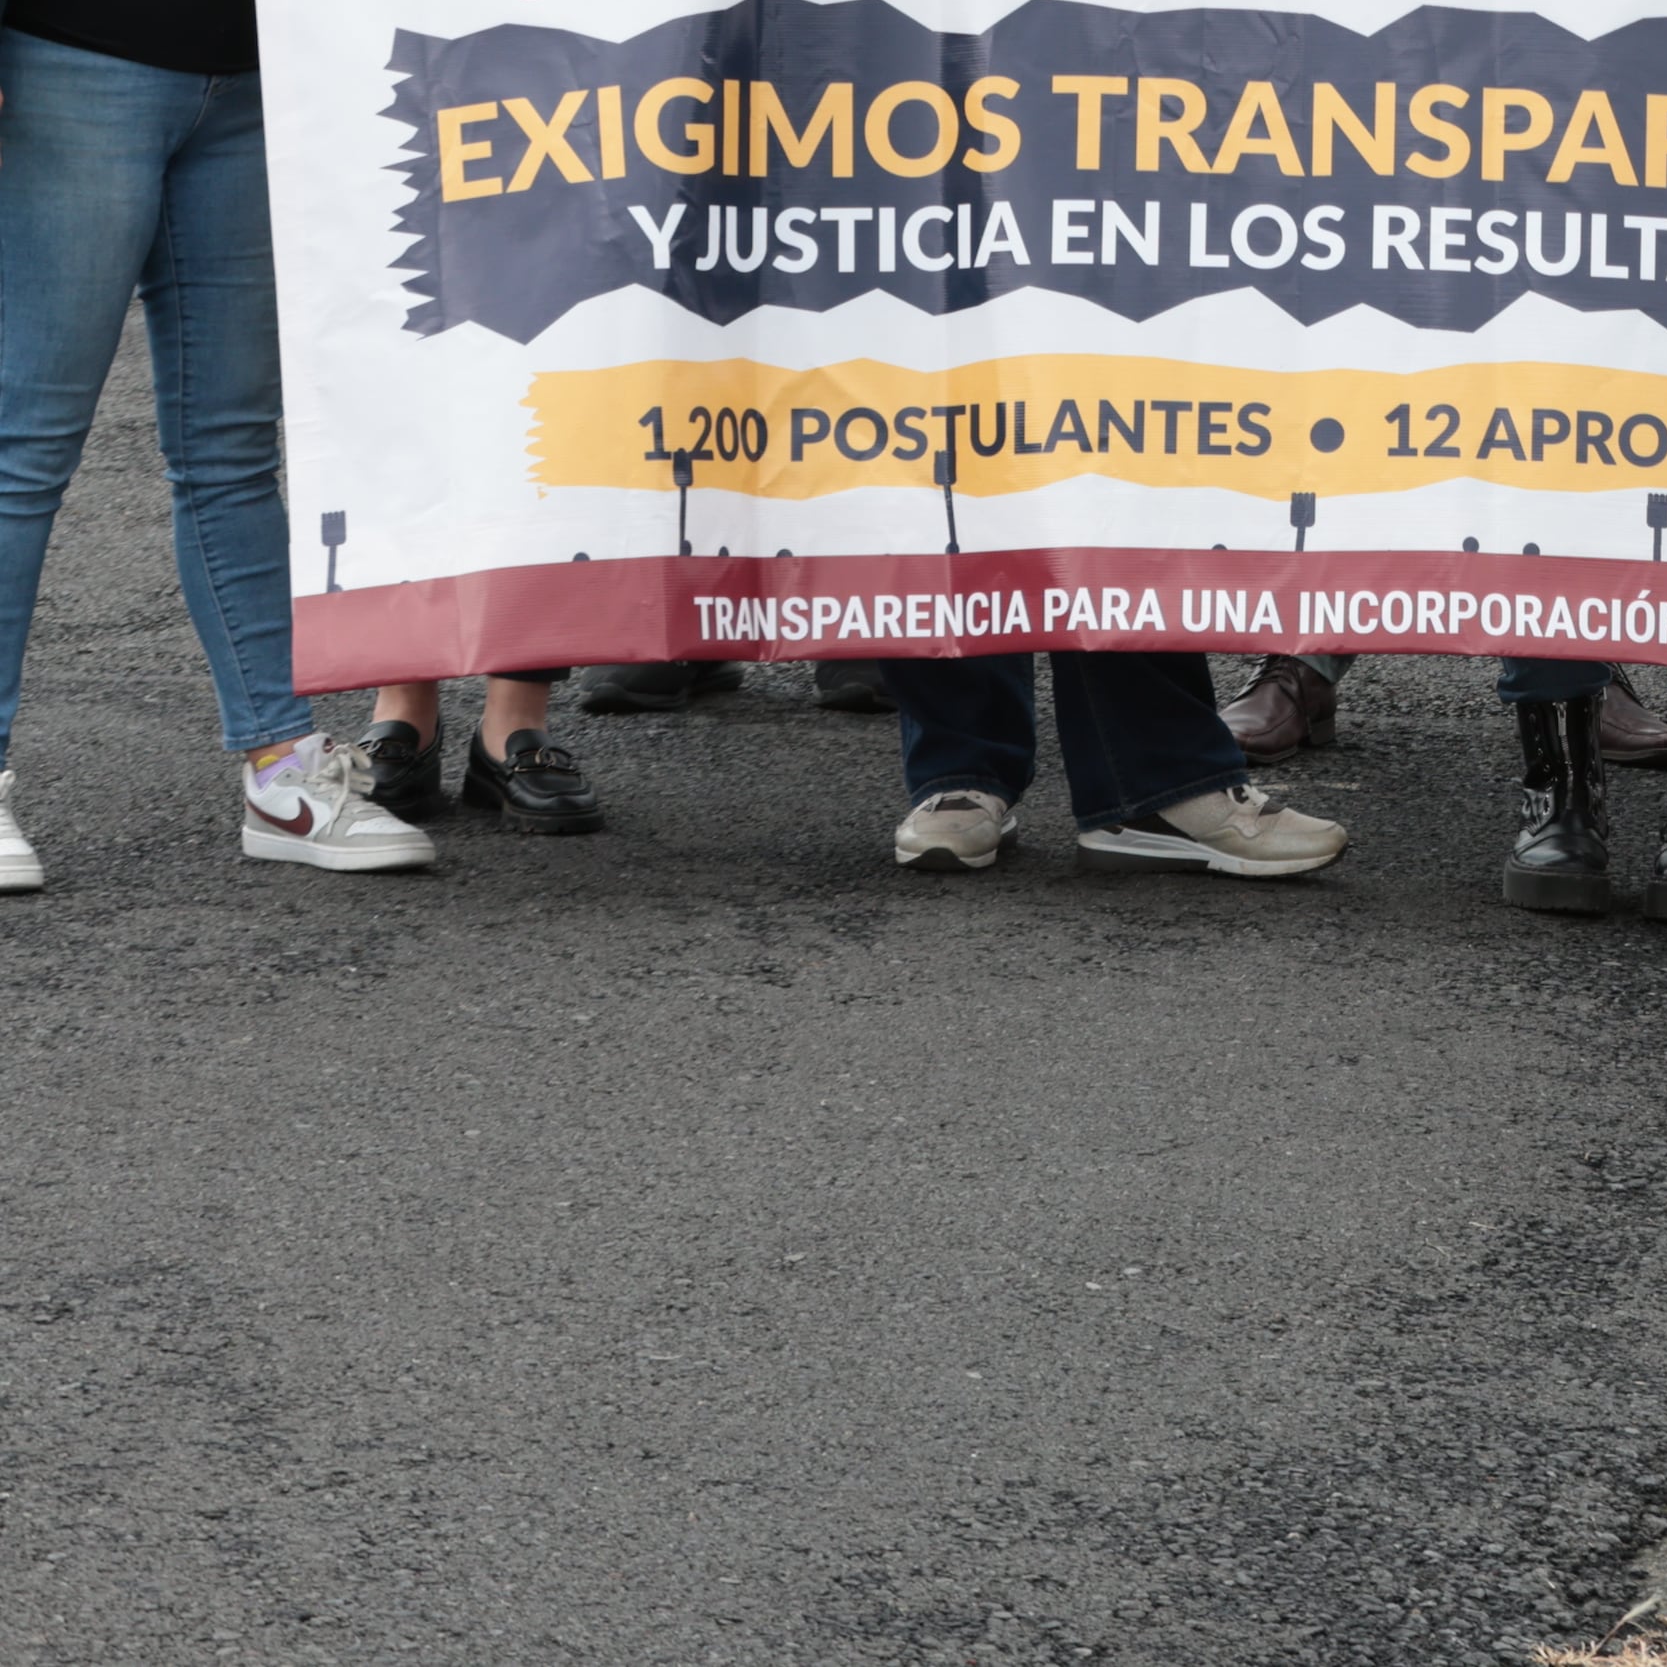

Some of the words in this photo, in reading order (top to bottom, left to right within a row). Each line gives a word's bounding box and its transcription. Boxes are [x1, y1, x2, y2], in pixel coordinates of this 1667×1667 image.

[439, 77, 1021, 200] EXIGIMOS
[627, 204, 686, 269] Y
[696, 201, 1031, 273] JUSTICIA
[1051, 199, 1160, 265] EN
[1190, 203, 1345, 270] LOS
[791, 400, 1271, 461] POSTULANTES
[1386, 405, 1459, 456] 12
[694, 591, 1031, 640] TRANSPARENCIA
[1044, 587, 1166, 631] PARA
[1182, 589, 1283, 634] UNA
